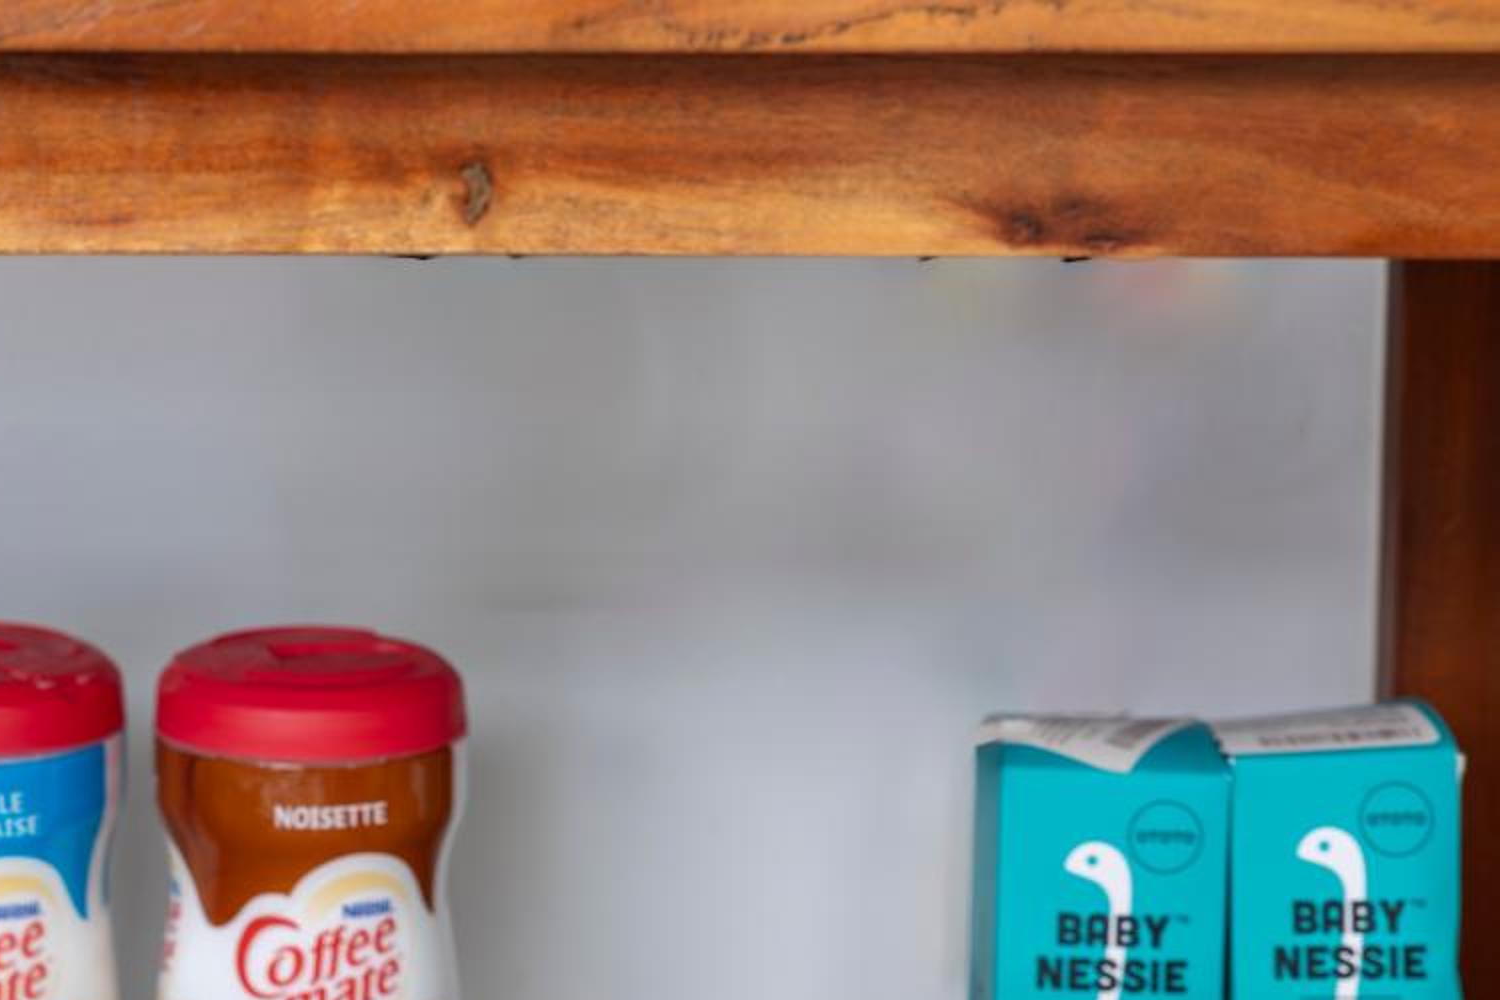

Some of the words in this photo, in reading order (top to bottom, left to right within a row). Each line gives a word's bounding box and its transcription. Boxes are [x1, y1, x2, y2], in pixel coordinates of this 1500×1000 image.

[272, 801, 388, 830] NOISETTE
[1056, 911, 1170, 949] BABY
[1292, 899, 1405, 935] BABY
[235, 915, 397, 1000] Coffee
[1035, 957, 1190, 995] NESSIE
[1273, 944, 1429, 981] NESSIE
